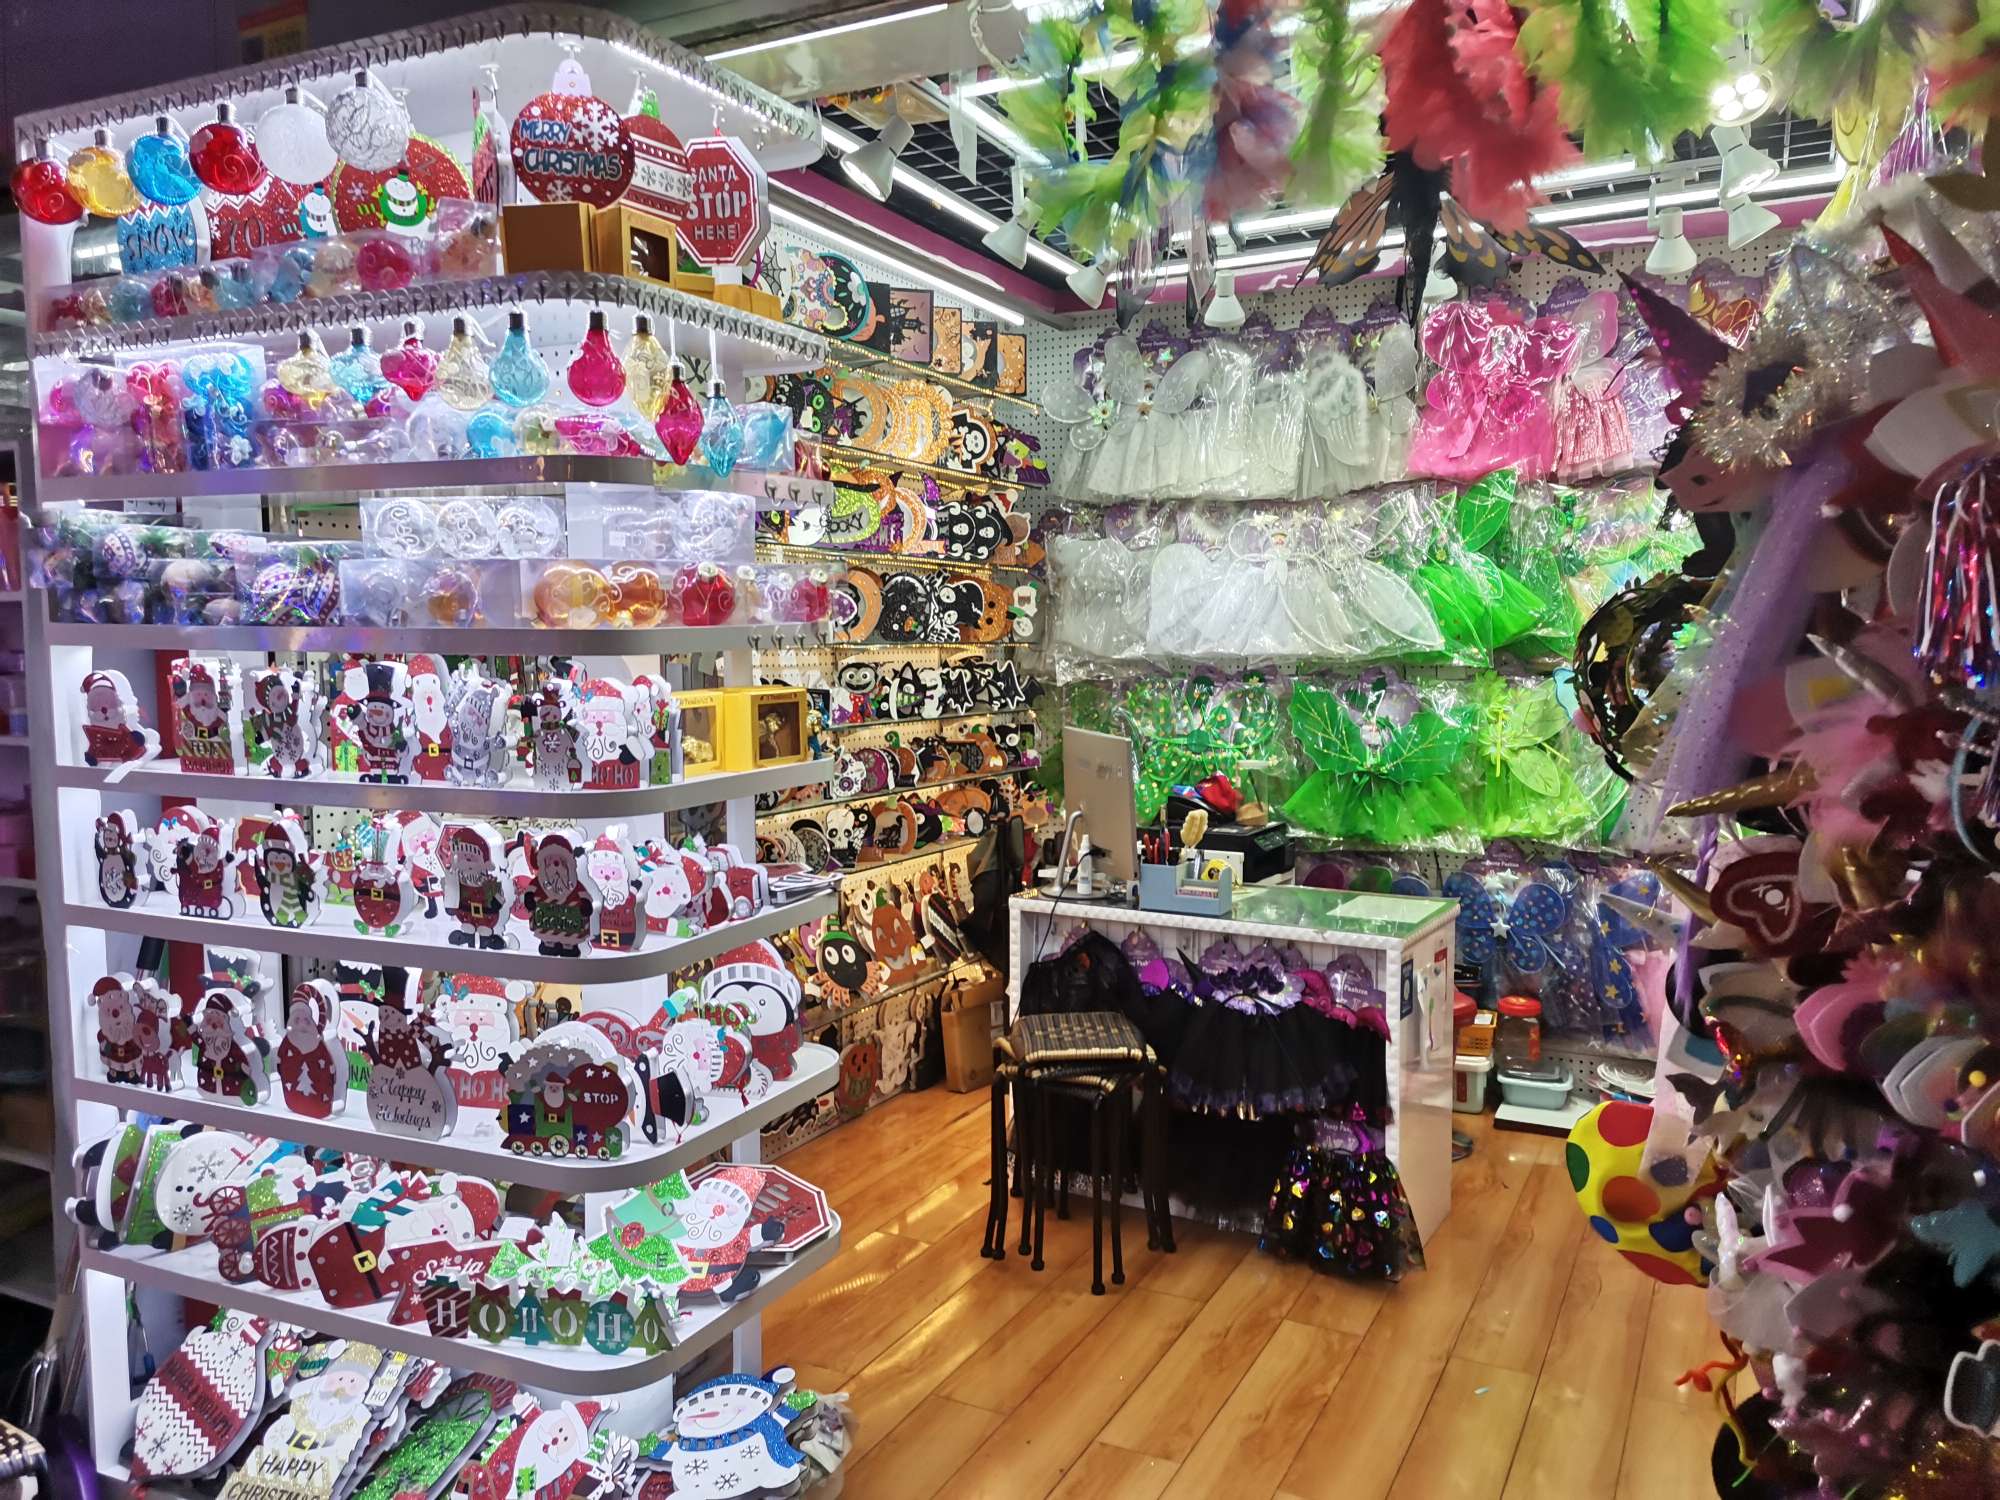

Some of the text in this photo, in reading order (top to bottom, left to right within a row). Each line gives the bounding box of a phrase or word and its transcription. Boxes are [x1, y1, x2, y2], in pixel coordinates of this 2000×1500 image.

[520, 119, 573, 144] MERRY
[524, 148, 623, 180] CHRISTMAS
[686, 190, 748, 220] STOP
[694, 223, 741, 241] HERE!
[380, 1076, 426, 1106] Happy
[583, 1091, 619, 1105] STOP
[412, 1258, 486, 1285] Sta
[258, 1453, 325, 1481] HAPPY
[227, 1481, 321, 1500] CHRISTM
